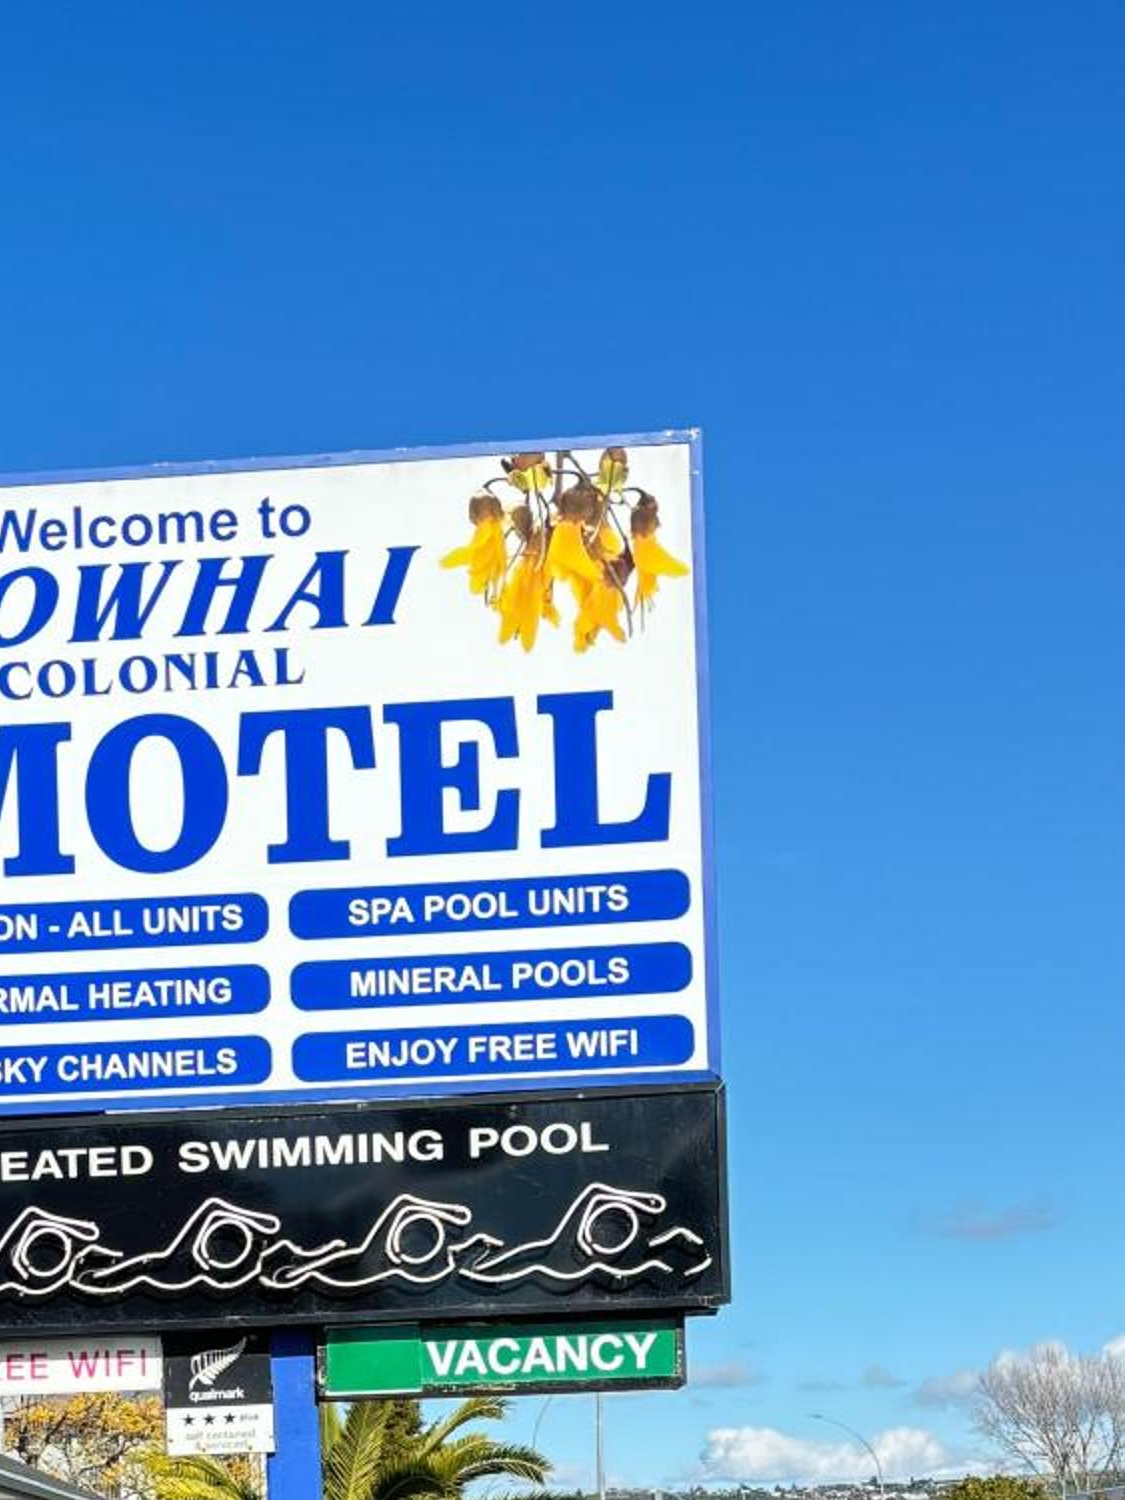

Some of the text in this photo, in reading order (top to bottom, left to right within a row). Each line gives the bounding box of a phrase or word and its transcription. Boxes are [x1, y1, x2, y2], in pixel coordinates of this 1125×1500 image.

[259, 498, 311, 539] to
[67, 910, 133, 938] ALL
[143, 904, 243, 935] UNITS
[348, 884, 629, 926] SPA POOL UNITS
[89, 977, 232, 1009] HEATING
[350, 957, 630, 997] MINERAL POOLS
[57, 1048, 237, 1081] CHANNELS
[346, 1029, 638, 1069] ENJOY FREE WIFI
[178, 1129, 444, 1173] SWIMMING
[469, 1122, 610, 1158] POOL
[68, 1348, 148, 1379] WIFI
[425, 1333, 658, 1376] VACANCY
[188, 1387, 245, 1402] qualmark
